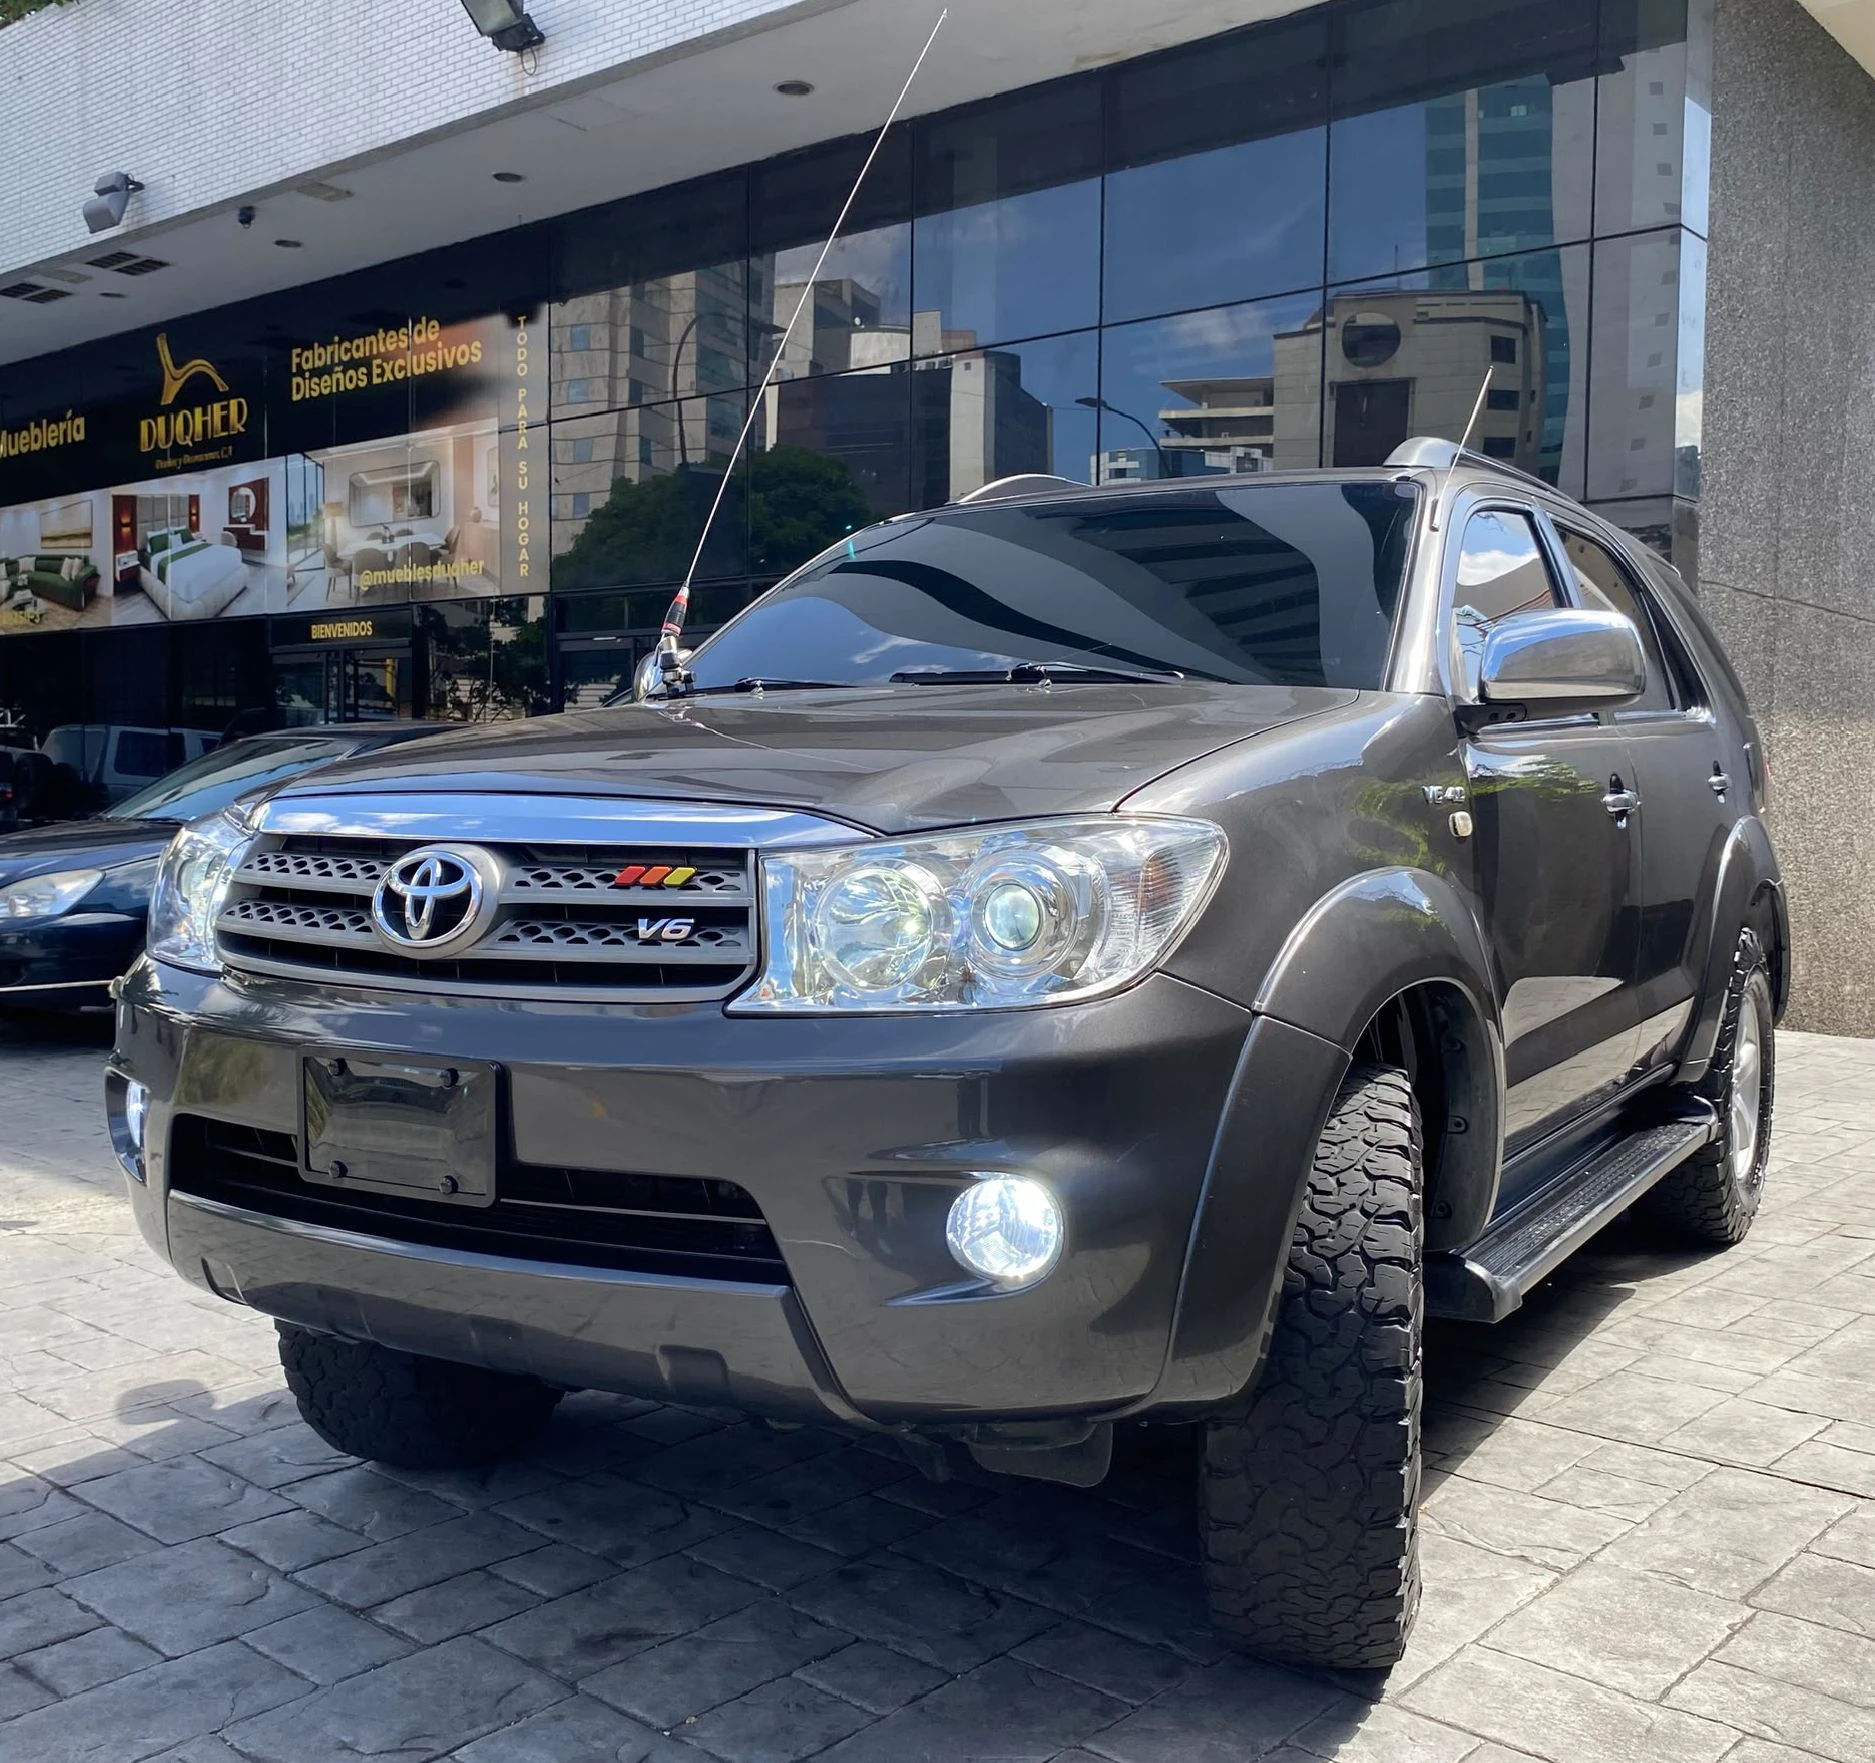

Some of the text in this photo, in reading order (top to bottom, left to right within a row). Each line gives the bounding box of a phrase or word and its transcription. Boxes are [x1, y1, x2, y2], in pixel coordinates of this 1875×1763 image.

[291, 316, 440, 373] Fabricantes de
[291, 340, 482, 402] Diseños Exclusivos
[140, 397, 248, 453] DUQHER
[516, 315, 529, 577] TODO PARA SU HOGAR
[359, 560, 485, 591] @mueblesduqher
[311, 620, 373, 640] BIENVENIDOS
[637, 918, 695, 940] V6
